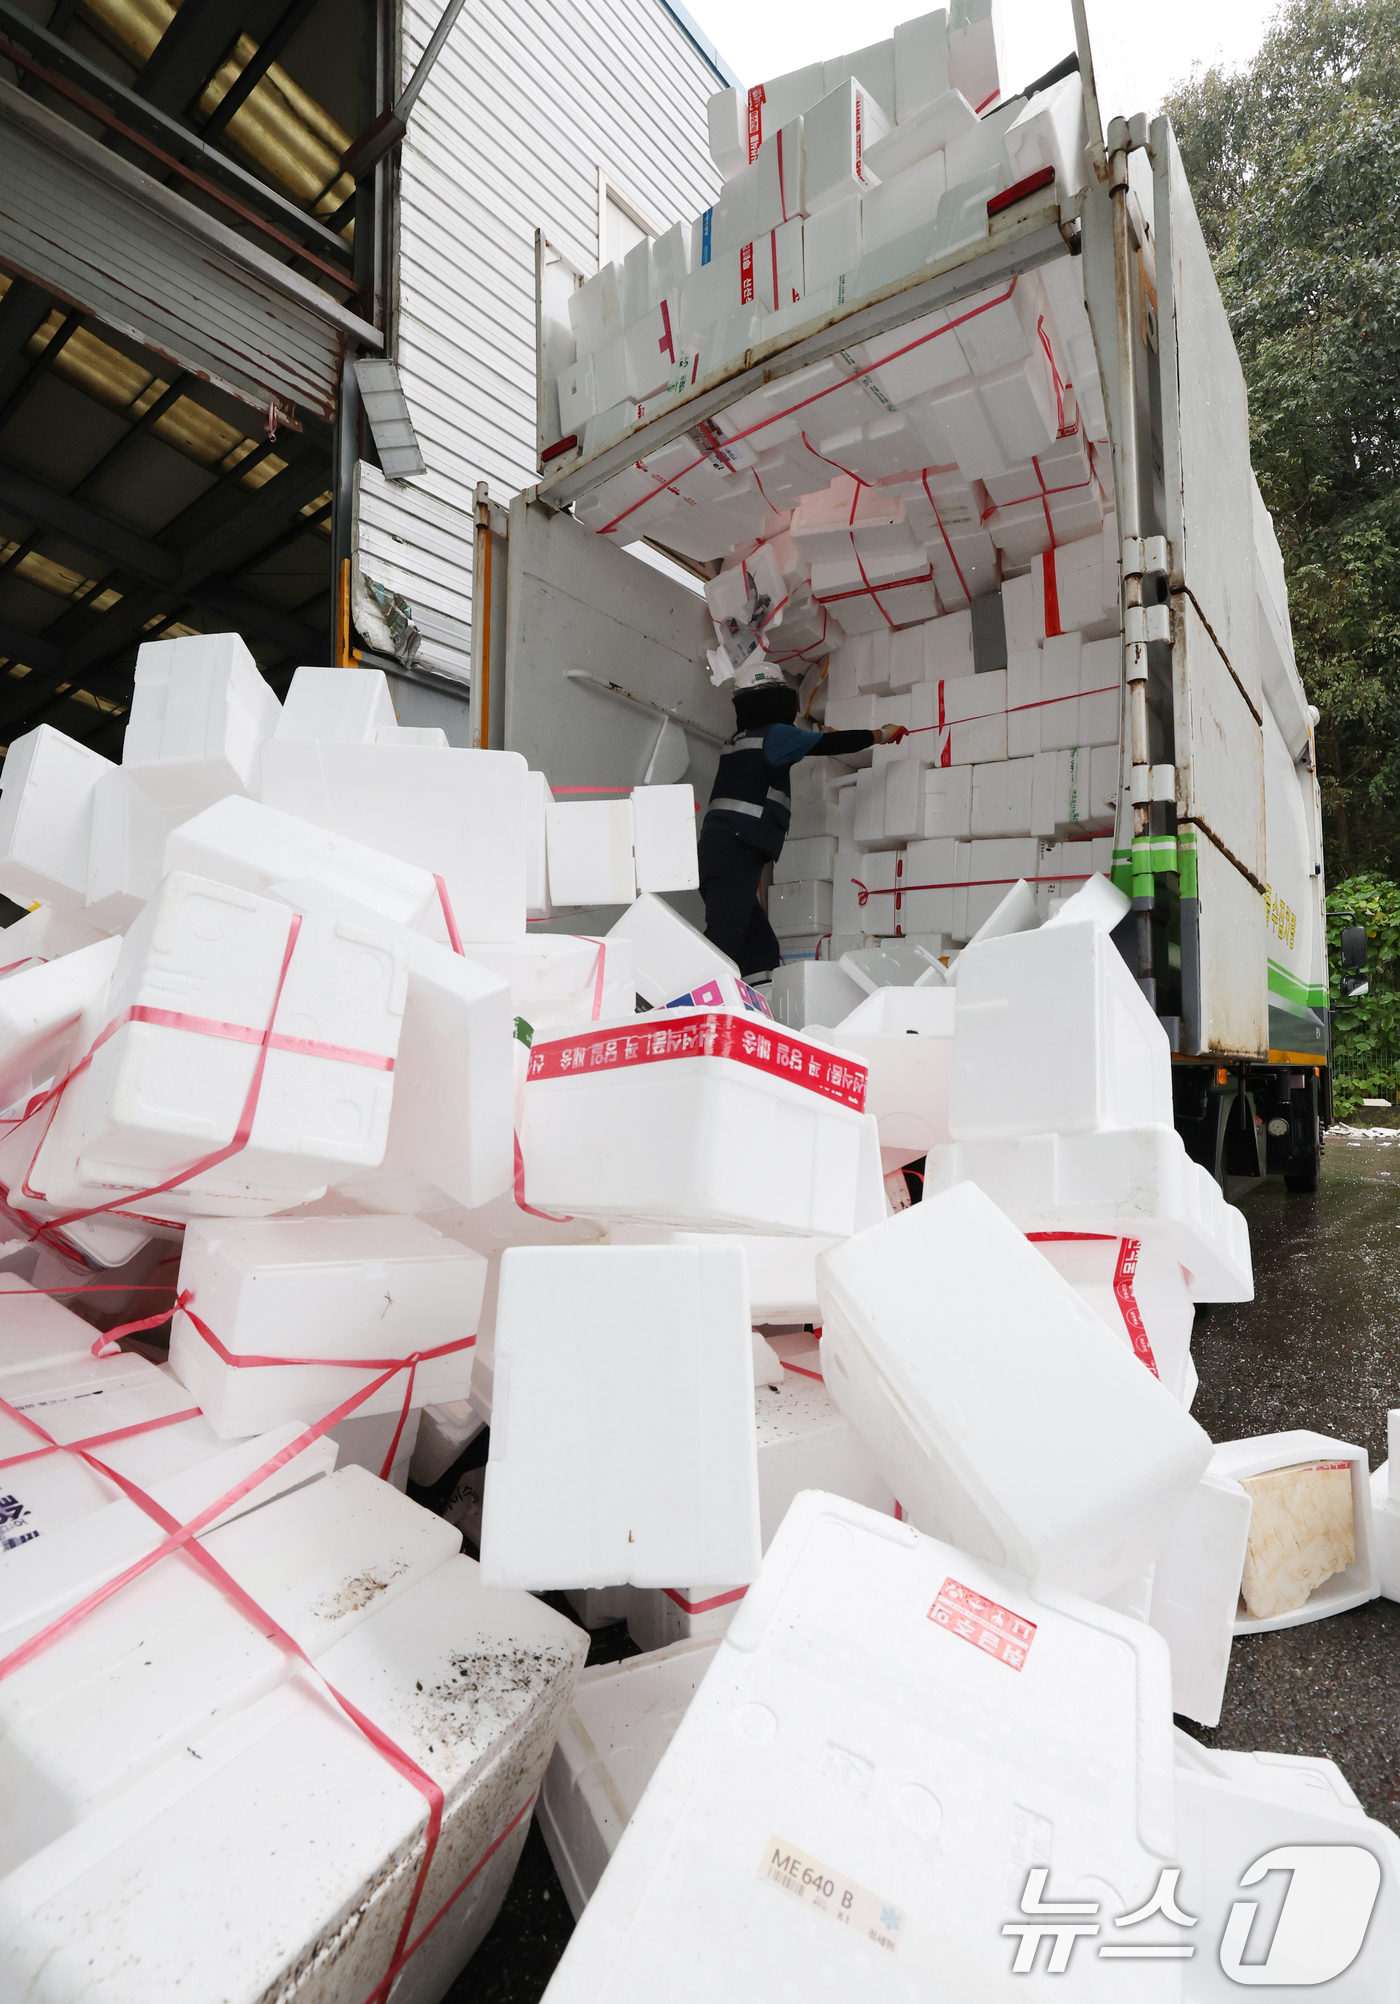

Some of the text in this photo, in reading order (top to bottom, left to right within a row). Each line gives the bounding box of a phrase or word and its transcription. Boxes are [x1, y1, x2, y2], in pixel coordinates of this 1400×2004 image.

[590, 1041, 617, 1066] 당일
[624, 1036, 639, 1061] 꼭
[742, 1030, 772, 1060] 배송
[776, 1042, 803, 1072] 당일
[527, 1052, 545, 1075] 신
[560, 1045, 587, 1071] 배송
[809, 1055, 821, 1078] 꼭
[826, 1063, 868, 1096] 선식품!
[840, 1890, 854, 1909] B
